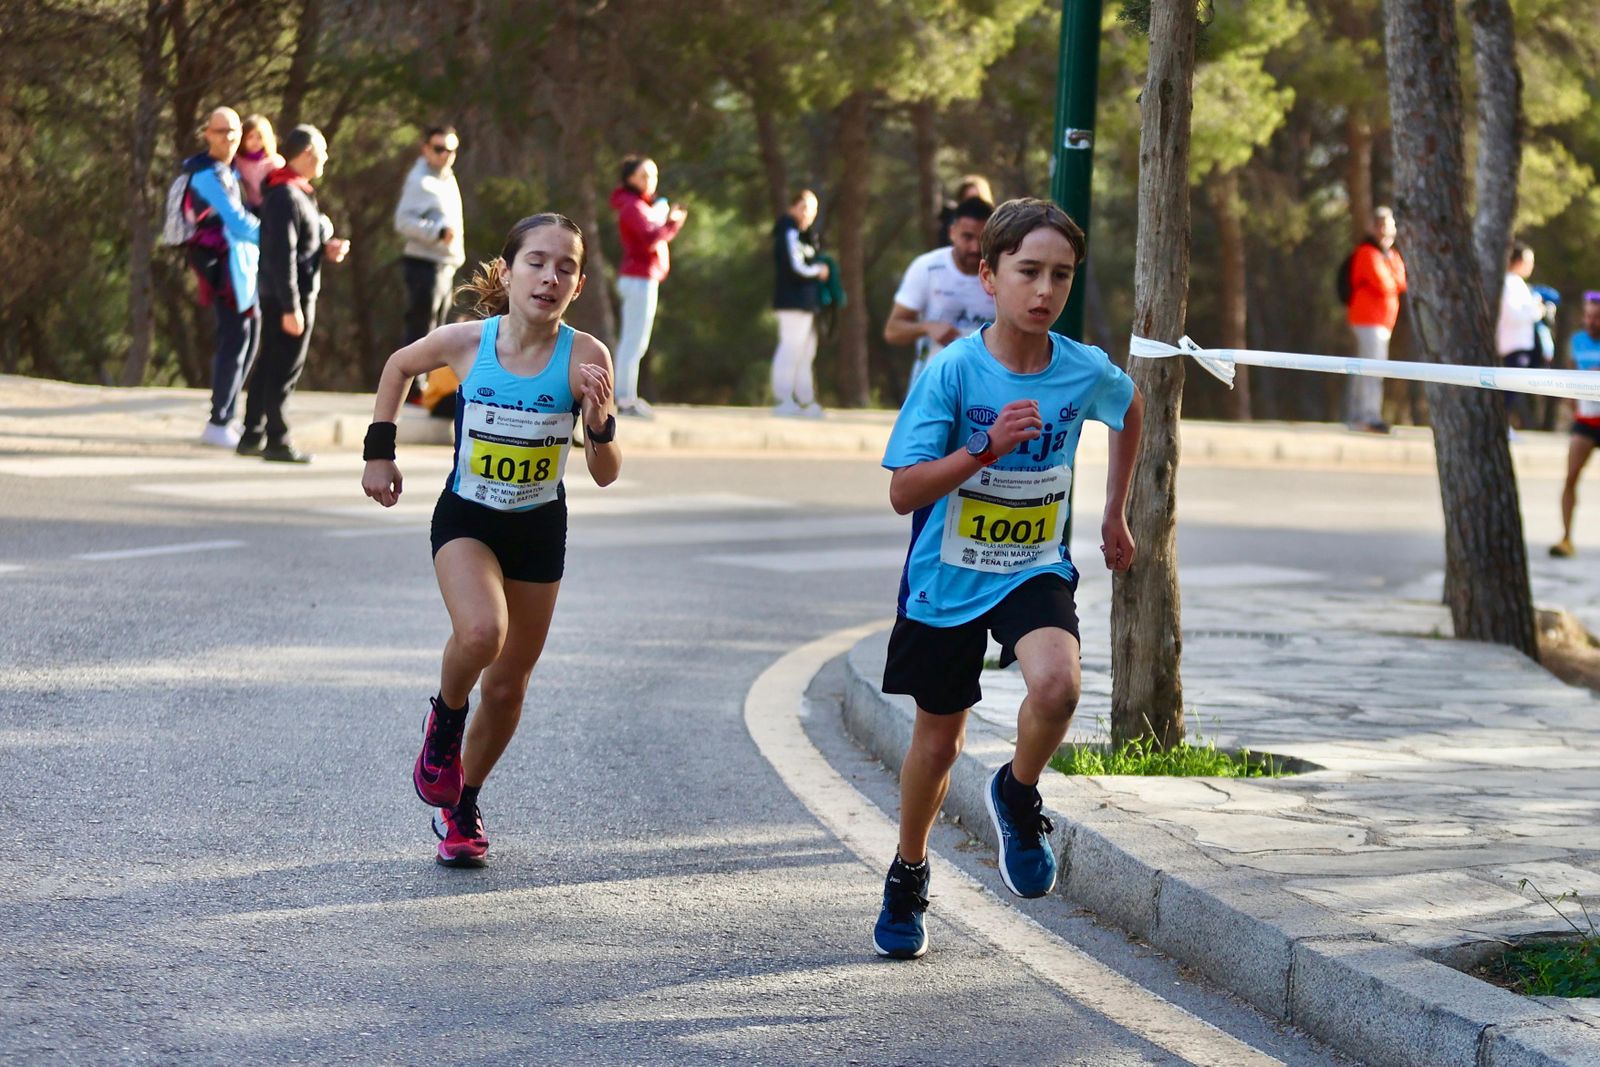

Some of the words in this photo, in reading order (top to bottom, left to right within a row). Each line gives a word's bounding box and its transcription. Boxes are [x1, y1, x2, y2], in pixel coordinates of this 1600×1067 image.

[497, 415, 533, 426] Ayuntamiento
[968, 409, 997, 423] TROPS
[480, 454, 551, 484] 1018
[993, 477, 1033, 485] Ayuntamiento
[970, 514, 1046, 544] 1001
[980, 558, 1001, 567] PEÑA
